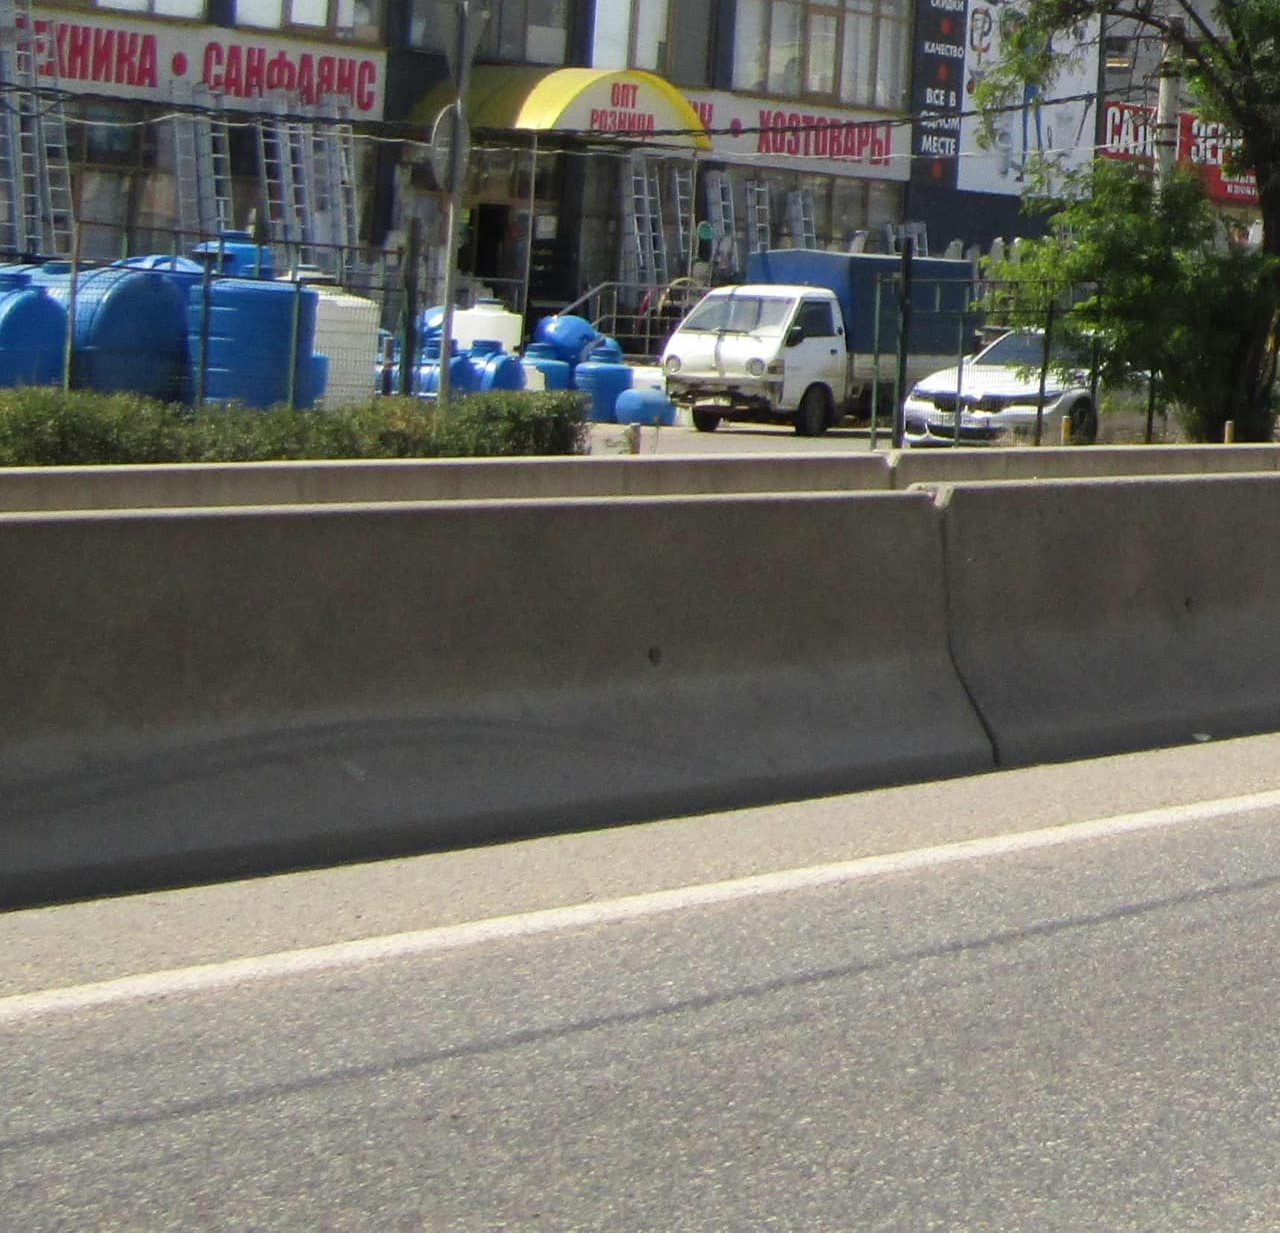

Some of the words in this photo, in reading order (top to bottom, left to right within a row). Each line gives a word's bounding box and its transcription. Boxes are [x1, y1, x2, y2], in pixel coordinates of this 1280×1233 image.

[924, 41, 964, 60] КАЧЕСТВО
[203, 41, 376, 111] САНФАЯНС
[611, 82, 639, 109] ОПТ
[926, 87, 945, 106] ВСЕ
[757, 109, 892, 166] ХОЗТОВАРЫ
[921, 134, 956, 155] МЕСТЕ
